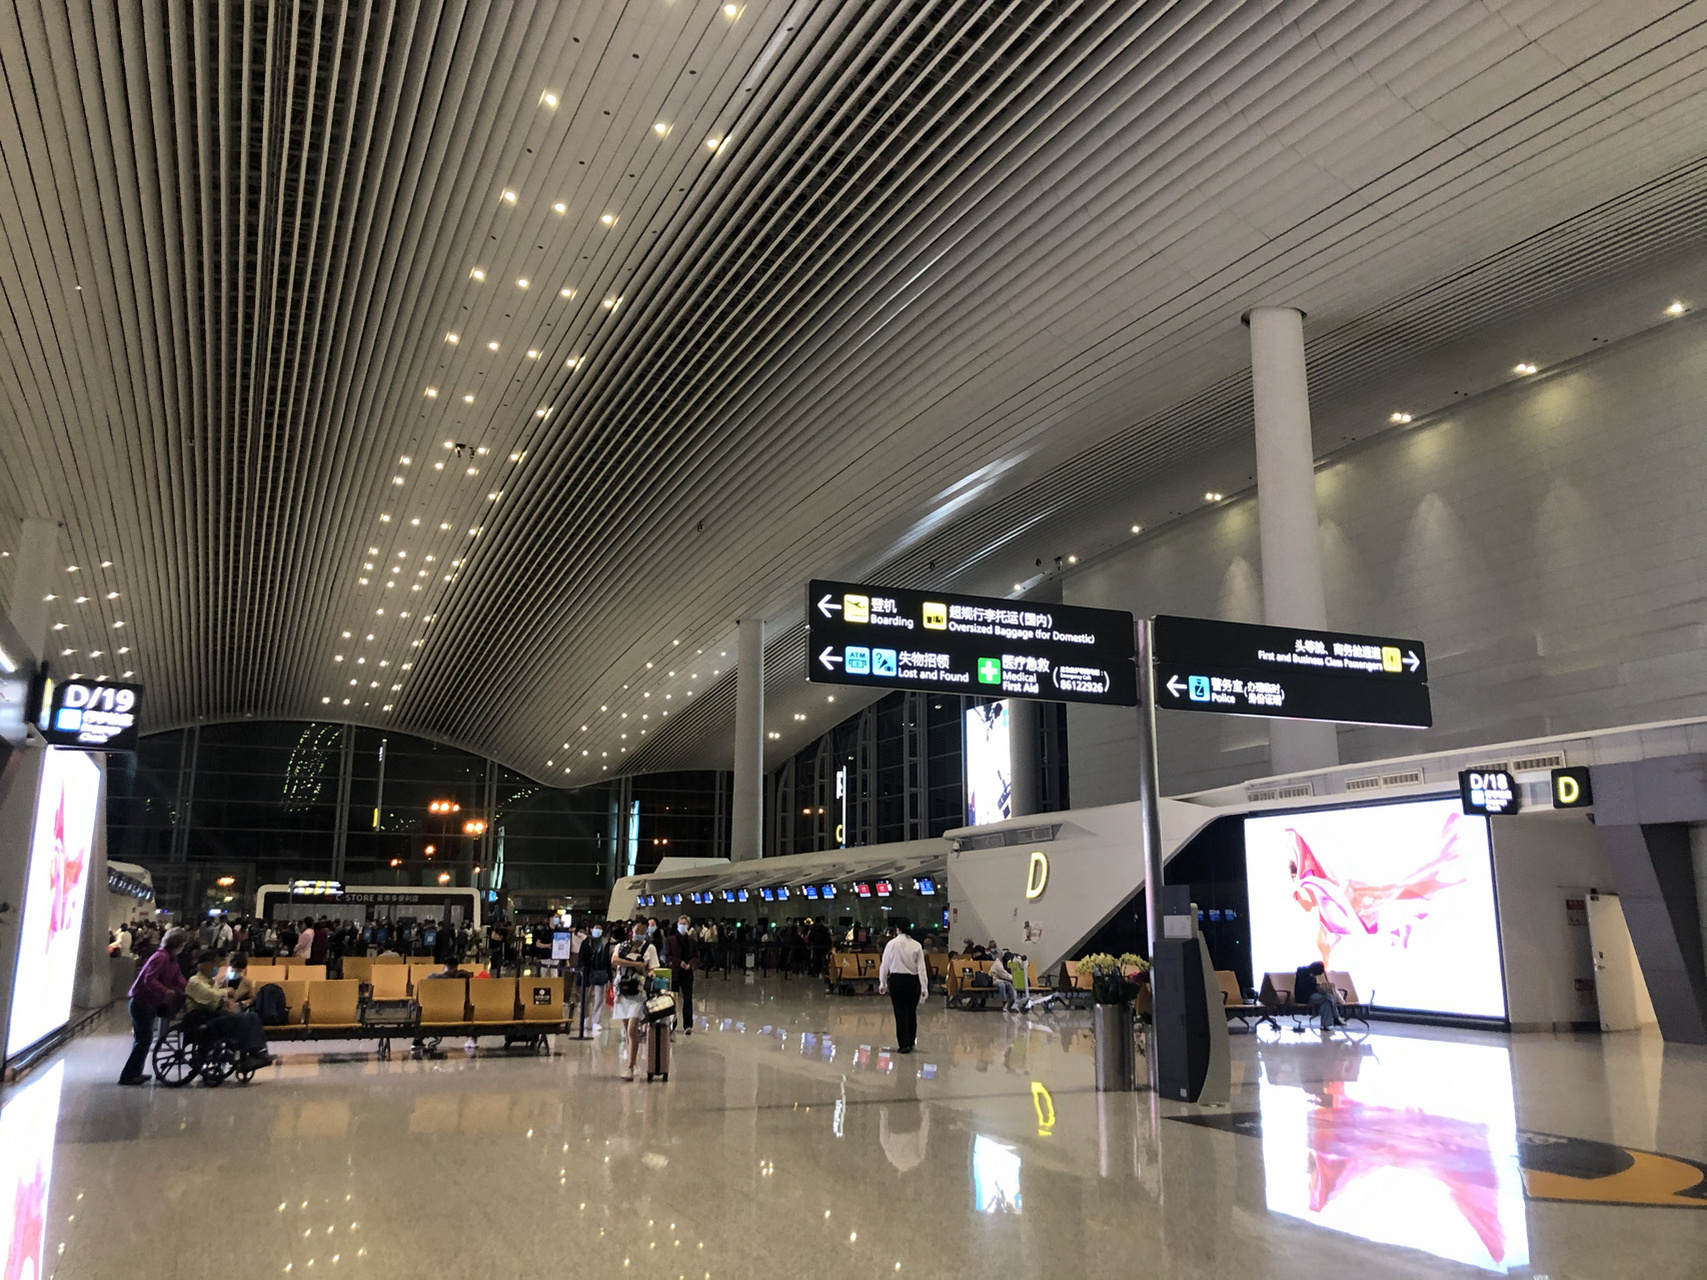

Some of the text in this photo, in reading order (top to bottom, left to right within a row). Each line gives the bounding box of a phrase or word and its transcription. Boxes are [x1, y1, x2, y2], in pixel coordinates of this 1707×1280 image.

[871, 598, 898, 613] 登机
[870, 614, 914, 629] Boarding
[949, 621, 1095, 644] Oversized Baggage (for Domestic)
[898, 651, 950, 669] 失物招领
[1002, 655, 1050, 673] 医疗急救
[1258, 650, 1275, 661] First
[1276, 653, 1292, 662] and
[1292, 653, 1324, 666] Business
[1324, 656, 1343, 668] Class
[898, 667, 970, 682] Lost and Found
[1002, 671, 1037, 683] Medical
[1002, 681, 1039, 694] First Aid
[1060, 679, 1104, 694] 86122926
[65, 684, 135, 713] D/19
[1211, 692, 1236, 704] Police
[1470, 773, 1508, 790] D/18
[1557, 776, 1580, 804] D
[1026, 851, 1049, 899] D
